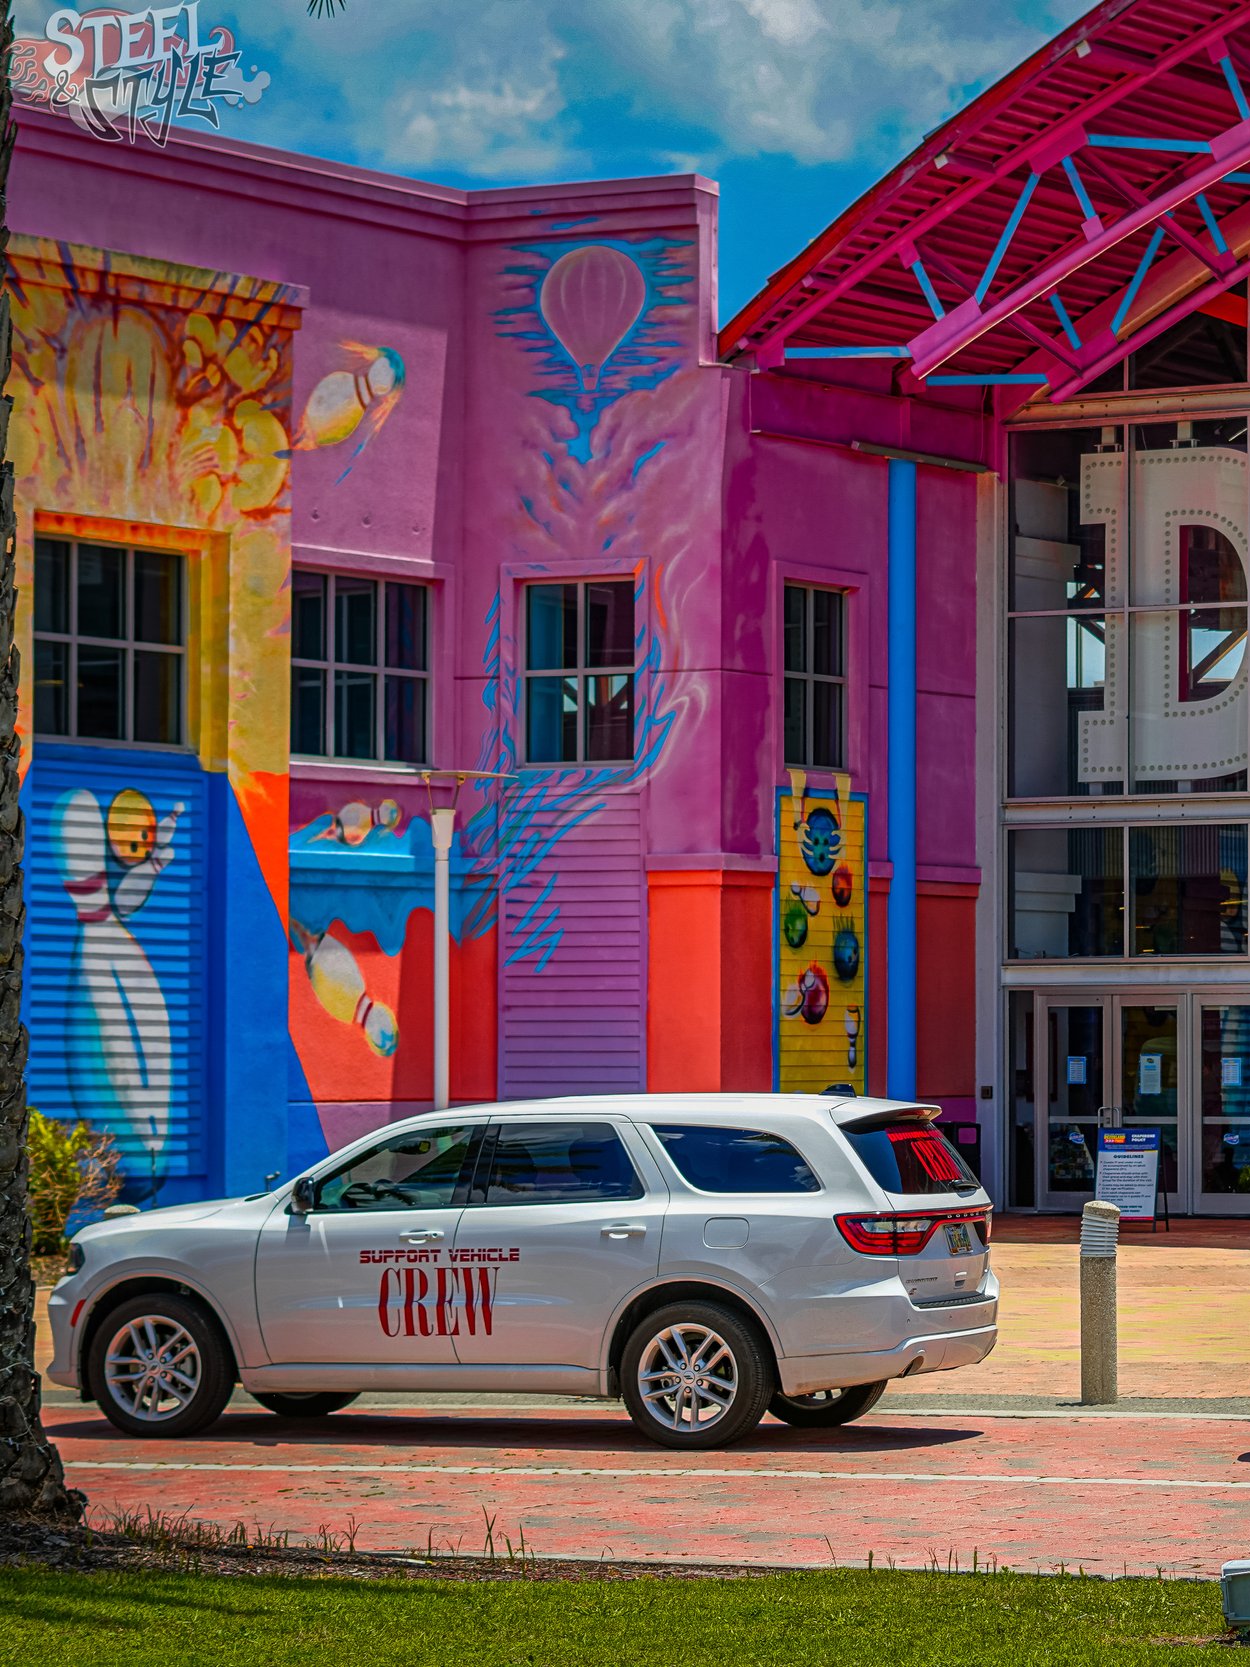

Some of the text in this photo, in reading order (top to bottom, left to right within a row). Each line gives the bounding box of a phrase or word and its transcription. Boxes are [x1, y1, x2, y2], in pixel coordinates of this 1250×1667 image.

[359, 1248, 520, 1264] SUPPORT VEHICLE
[378, 1266, 501, 1338] CREW
